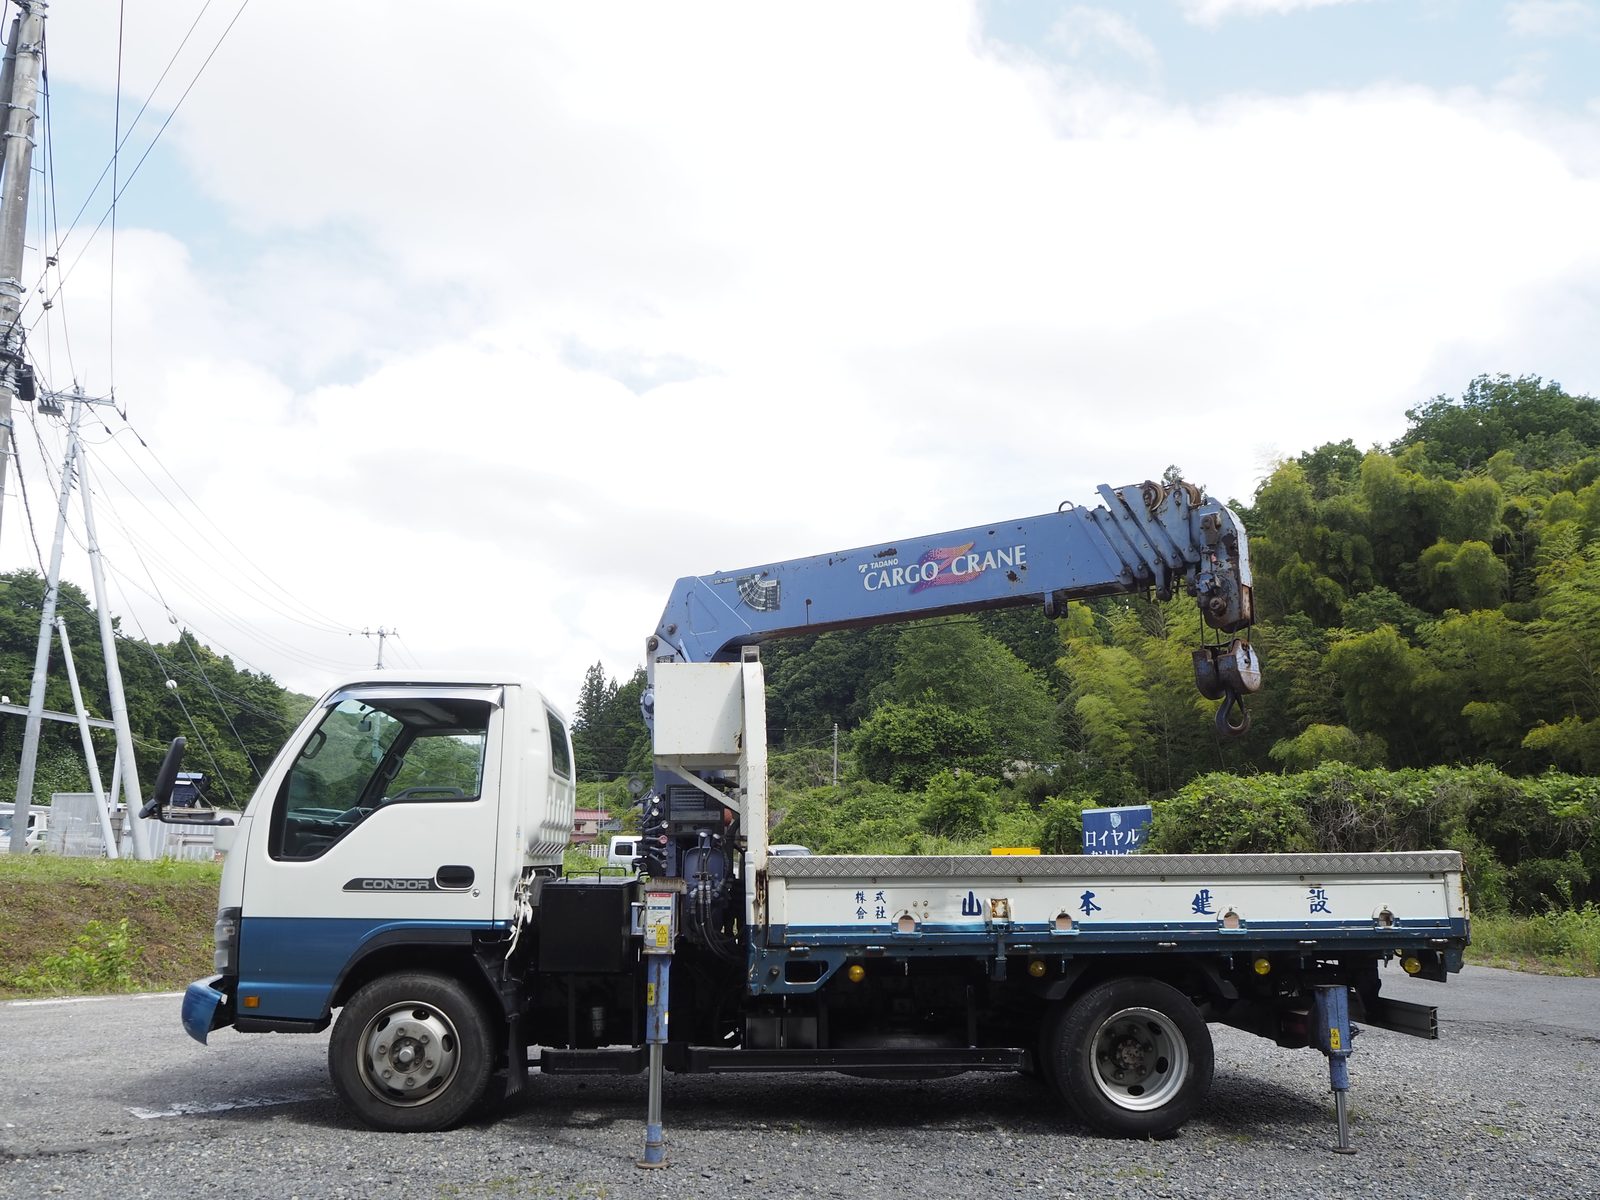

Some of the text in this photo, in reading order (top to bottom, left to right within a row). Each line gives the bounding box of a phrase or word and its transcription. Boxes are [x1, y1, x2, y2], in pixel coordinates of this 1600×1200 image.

[863, 544, 1027, 592] CARGO CRANE
[869, 558, 899, 570] TADANO
[1085, 828, 1140, 847] ロイヤル
[362, 879, 430, 889] CONDOR
